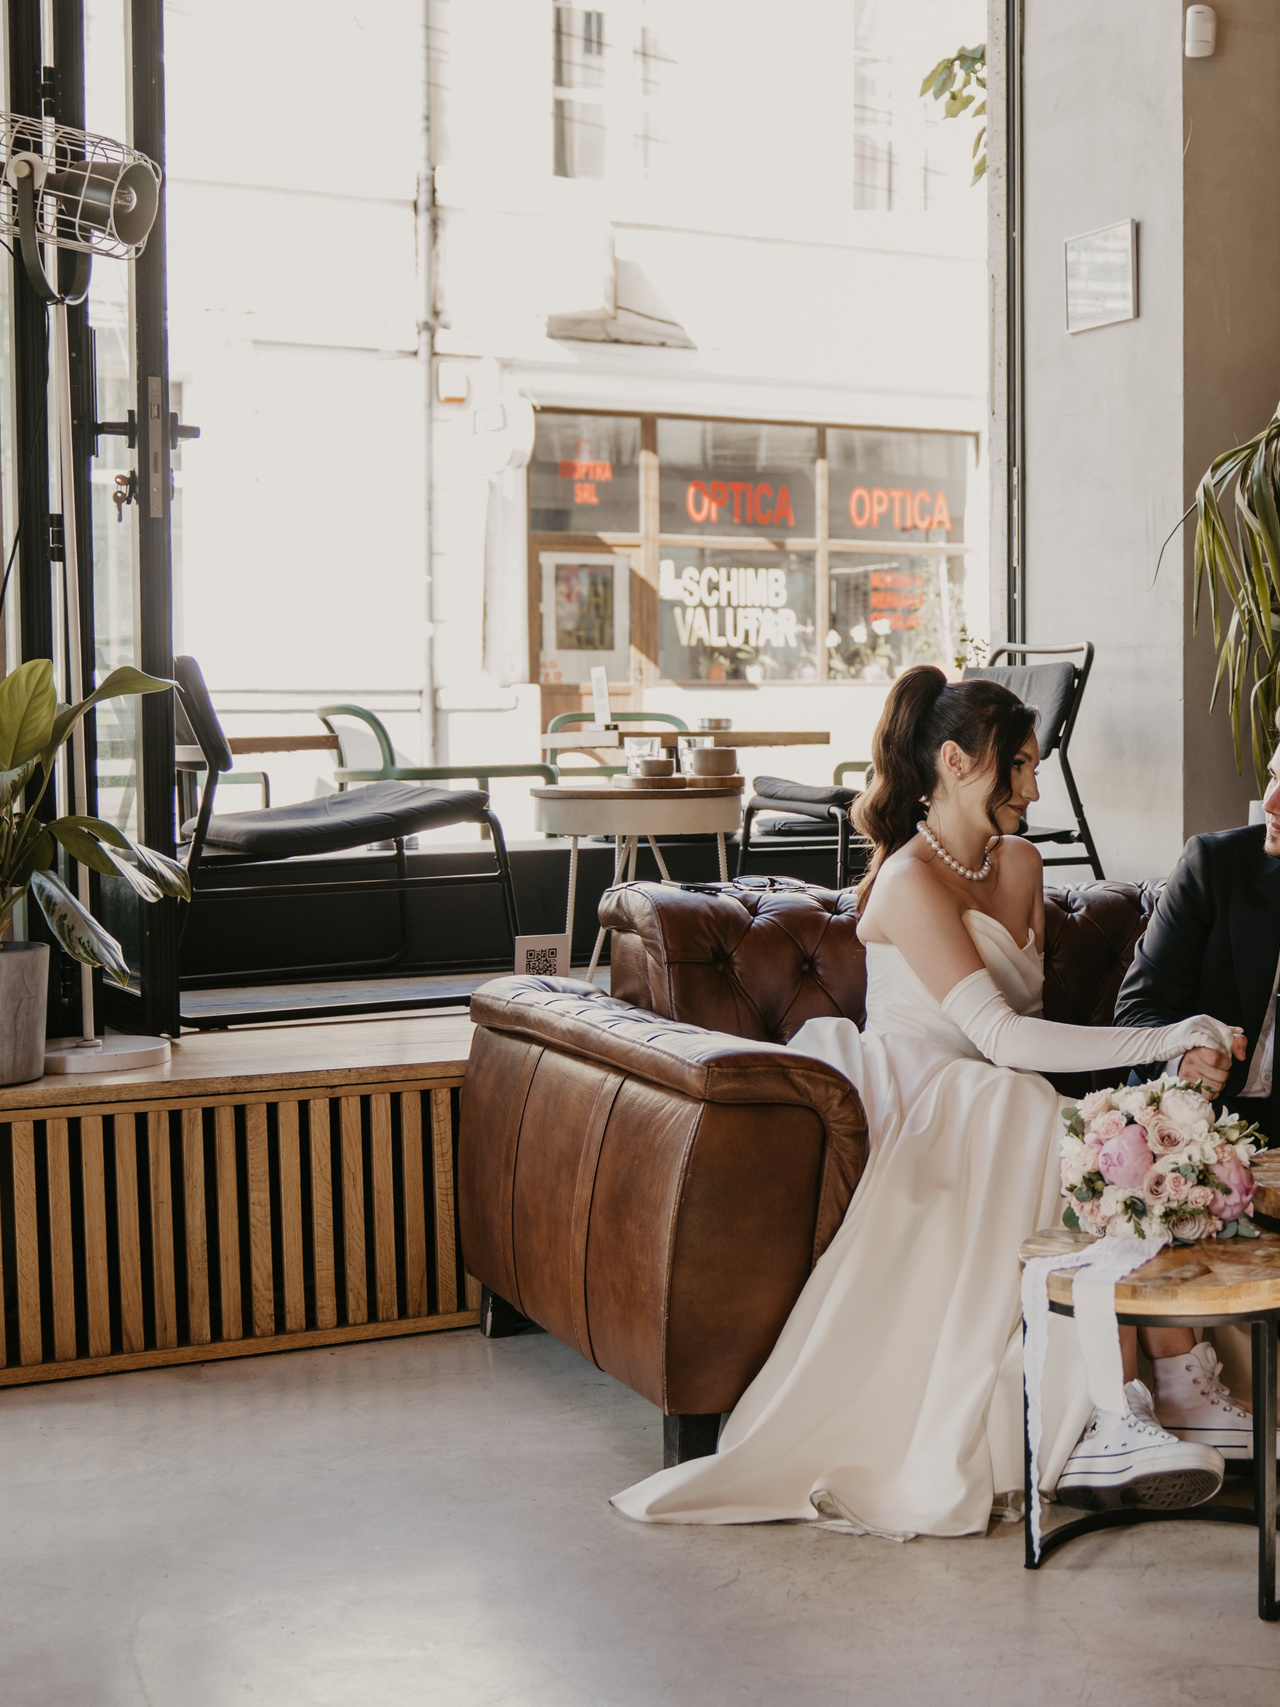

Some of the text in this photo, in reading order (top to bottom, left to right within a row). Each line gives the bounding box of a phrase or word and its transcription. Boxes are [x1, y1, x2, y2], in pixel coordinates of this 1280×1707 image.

[686, 480, 795, 527] OPTICA
[849, 485, 953, 531] OPTICA
[681, 566, 787, 607] SCHIMB
[673, 607, 798, 648] VALUTAR
